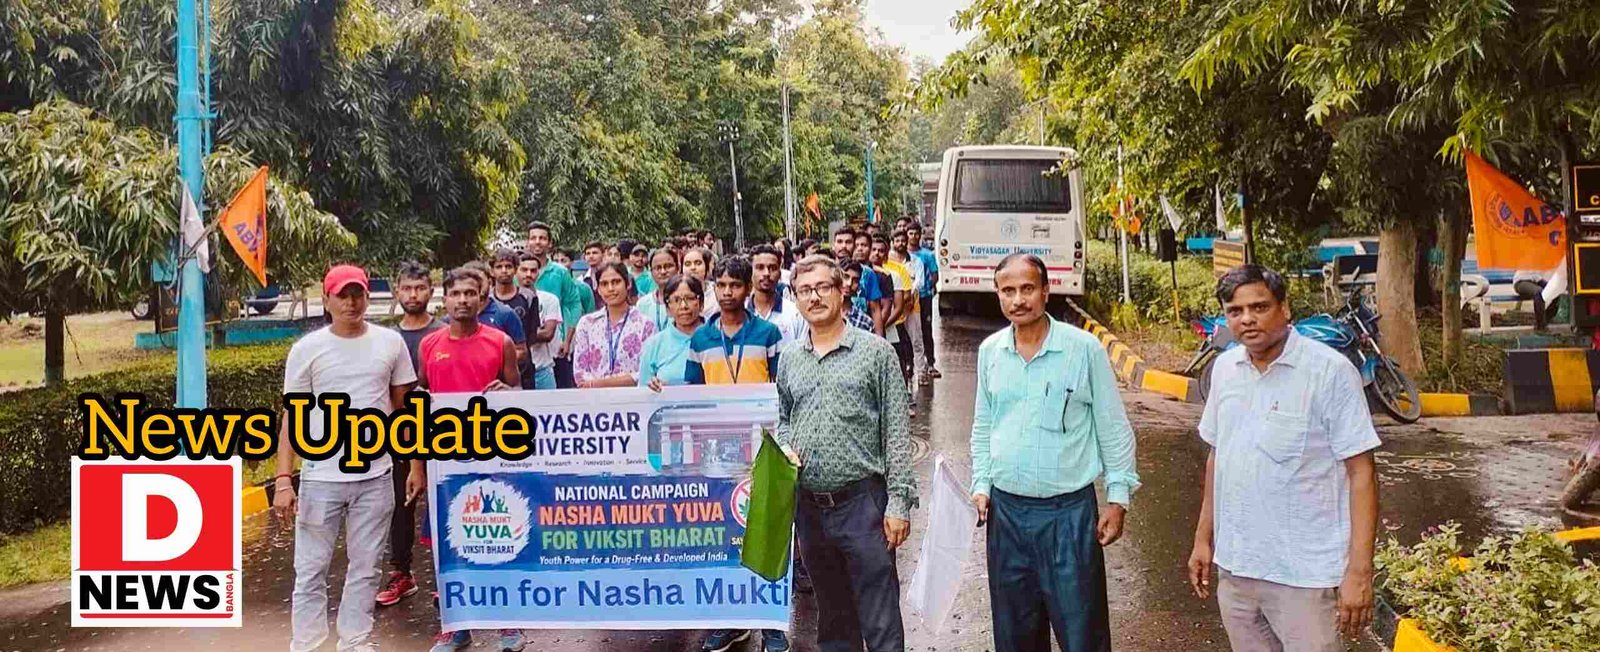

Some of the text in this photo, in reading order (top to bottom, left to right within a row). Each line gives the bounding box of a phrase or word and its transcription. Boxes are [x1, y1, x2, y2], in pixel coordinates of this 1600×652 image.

[626, 458, 648, 466] Service
[555, 483, 709, 501] NATIONAL CAMPAIGN
[539, 502, 725, 525] NASHA MUKT YUVA
[462, 525, 512, 538] YUVA
[542, 526, 726, 550] FOR VIKSIT BHARAT
[463, 545, 514, 554] VIKSIT BHARAT
[540, 556, 562, 565] Youth
[564, 556, 589, 565] Power
[591, 555, 602, 564] for
[611, 554, 652, 566] Drug-Free
[654, 553, 661, 563] &
[663, 552, 706, 563] Developed
[707, 551, 728, 562] India
[446, 576, 789, 609] Run for Nasha Mukti
